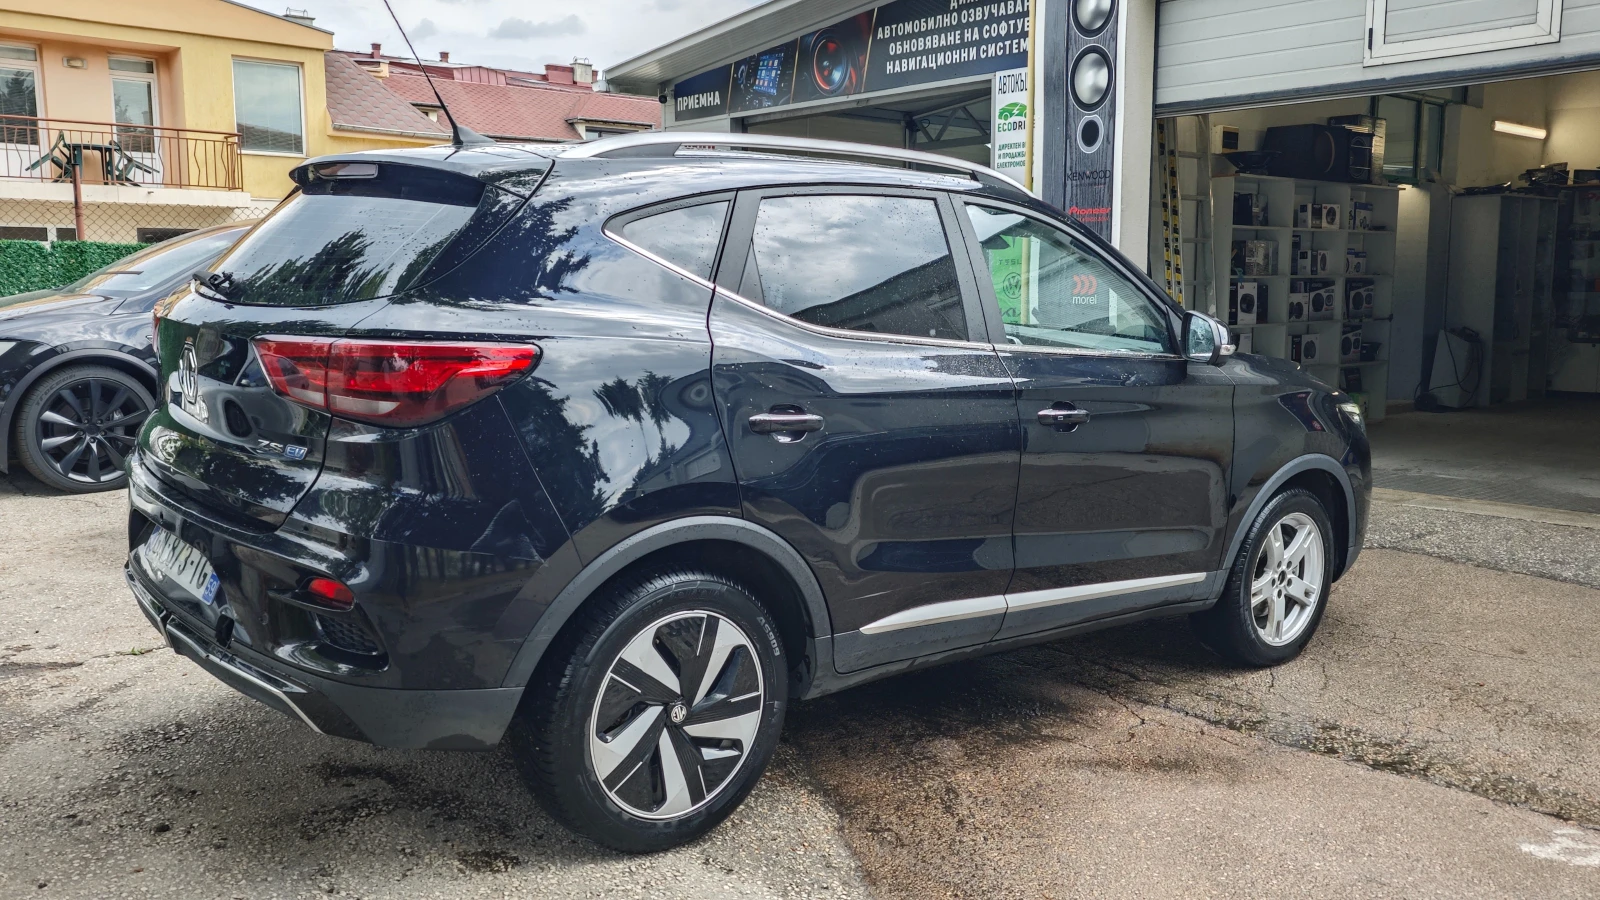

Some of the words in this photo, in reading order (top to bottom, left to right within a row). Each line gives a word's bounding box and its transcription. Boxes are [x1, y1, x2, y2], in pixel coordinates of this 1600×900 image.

[877, 12, 958, 40] АВТОМОБИЛНО
[889, 32, 961, 55] ОБНОВЯВАНЕ
[964, 27, 980, 42] НА
[886, 47, 977, 74] НАВИГАЦИОННИ
[677, 90, 720, 112] ПРИЕМНА
[998, 142, 1021, 151] ДИРЕКТЕН
[1066, 170, 1111, 181] KENWOOD
[1068, 206, 1111, 216] Pioneer
[1072, 295, 1097, 305] morel
[257, 439, 283, 454] ZS
[286, 446, 306, 459] EV
[205, 580, 217, 597] 59
[756, 616, 780, 657] AS909
